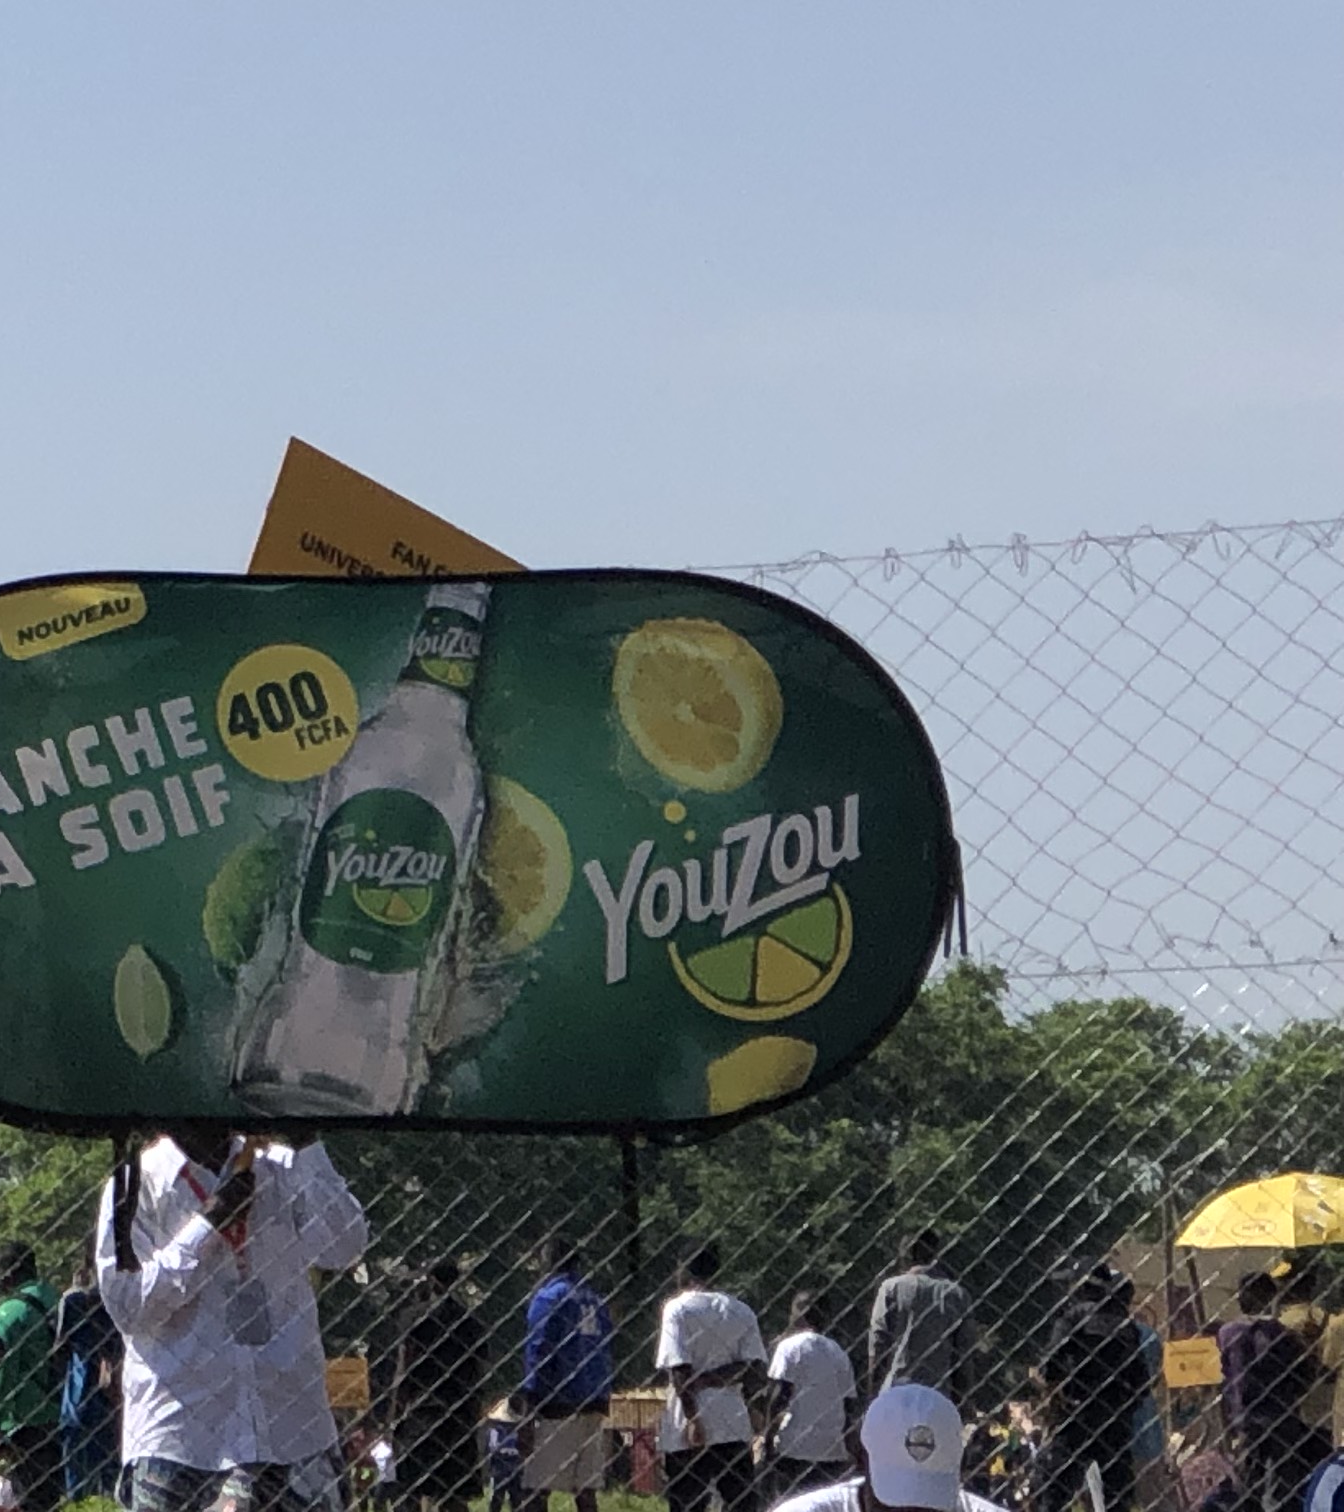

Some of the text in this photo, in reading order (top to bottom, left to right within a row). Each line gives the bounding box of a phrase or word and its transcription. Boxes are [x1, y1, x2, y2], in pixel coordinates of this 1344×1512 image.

[16, 596, 131, 646] NOUVEAU
[227, 669, 330, 742] 400
[294, 715, 350, 752] FCFA
[58, 762, 231, 871] SOIF
[323, 842, 447, 897] YouZou
[582, 792, 862, 985] YouZou
